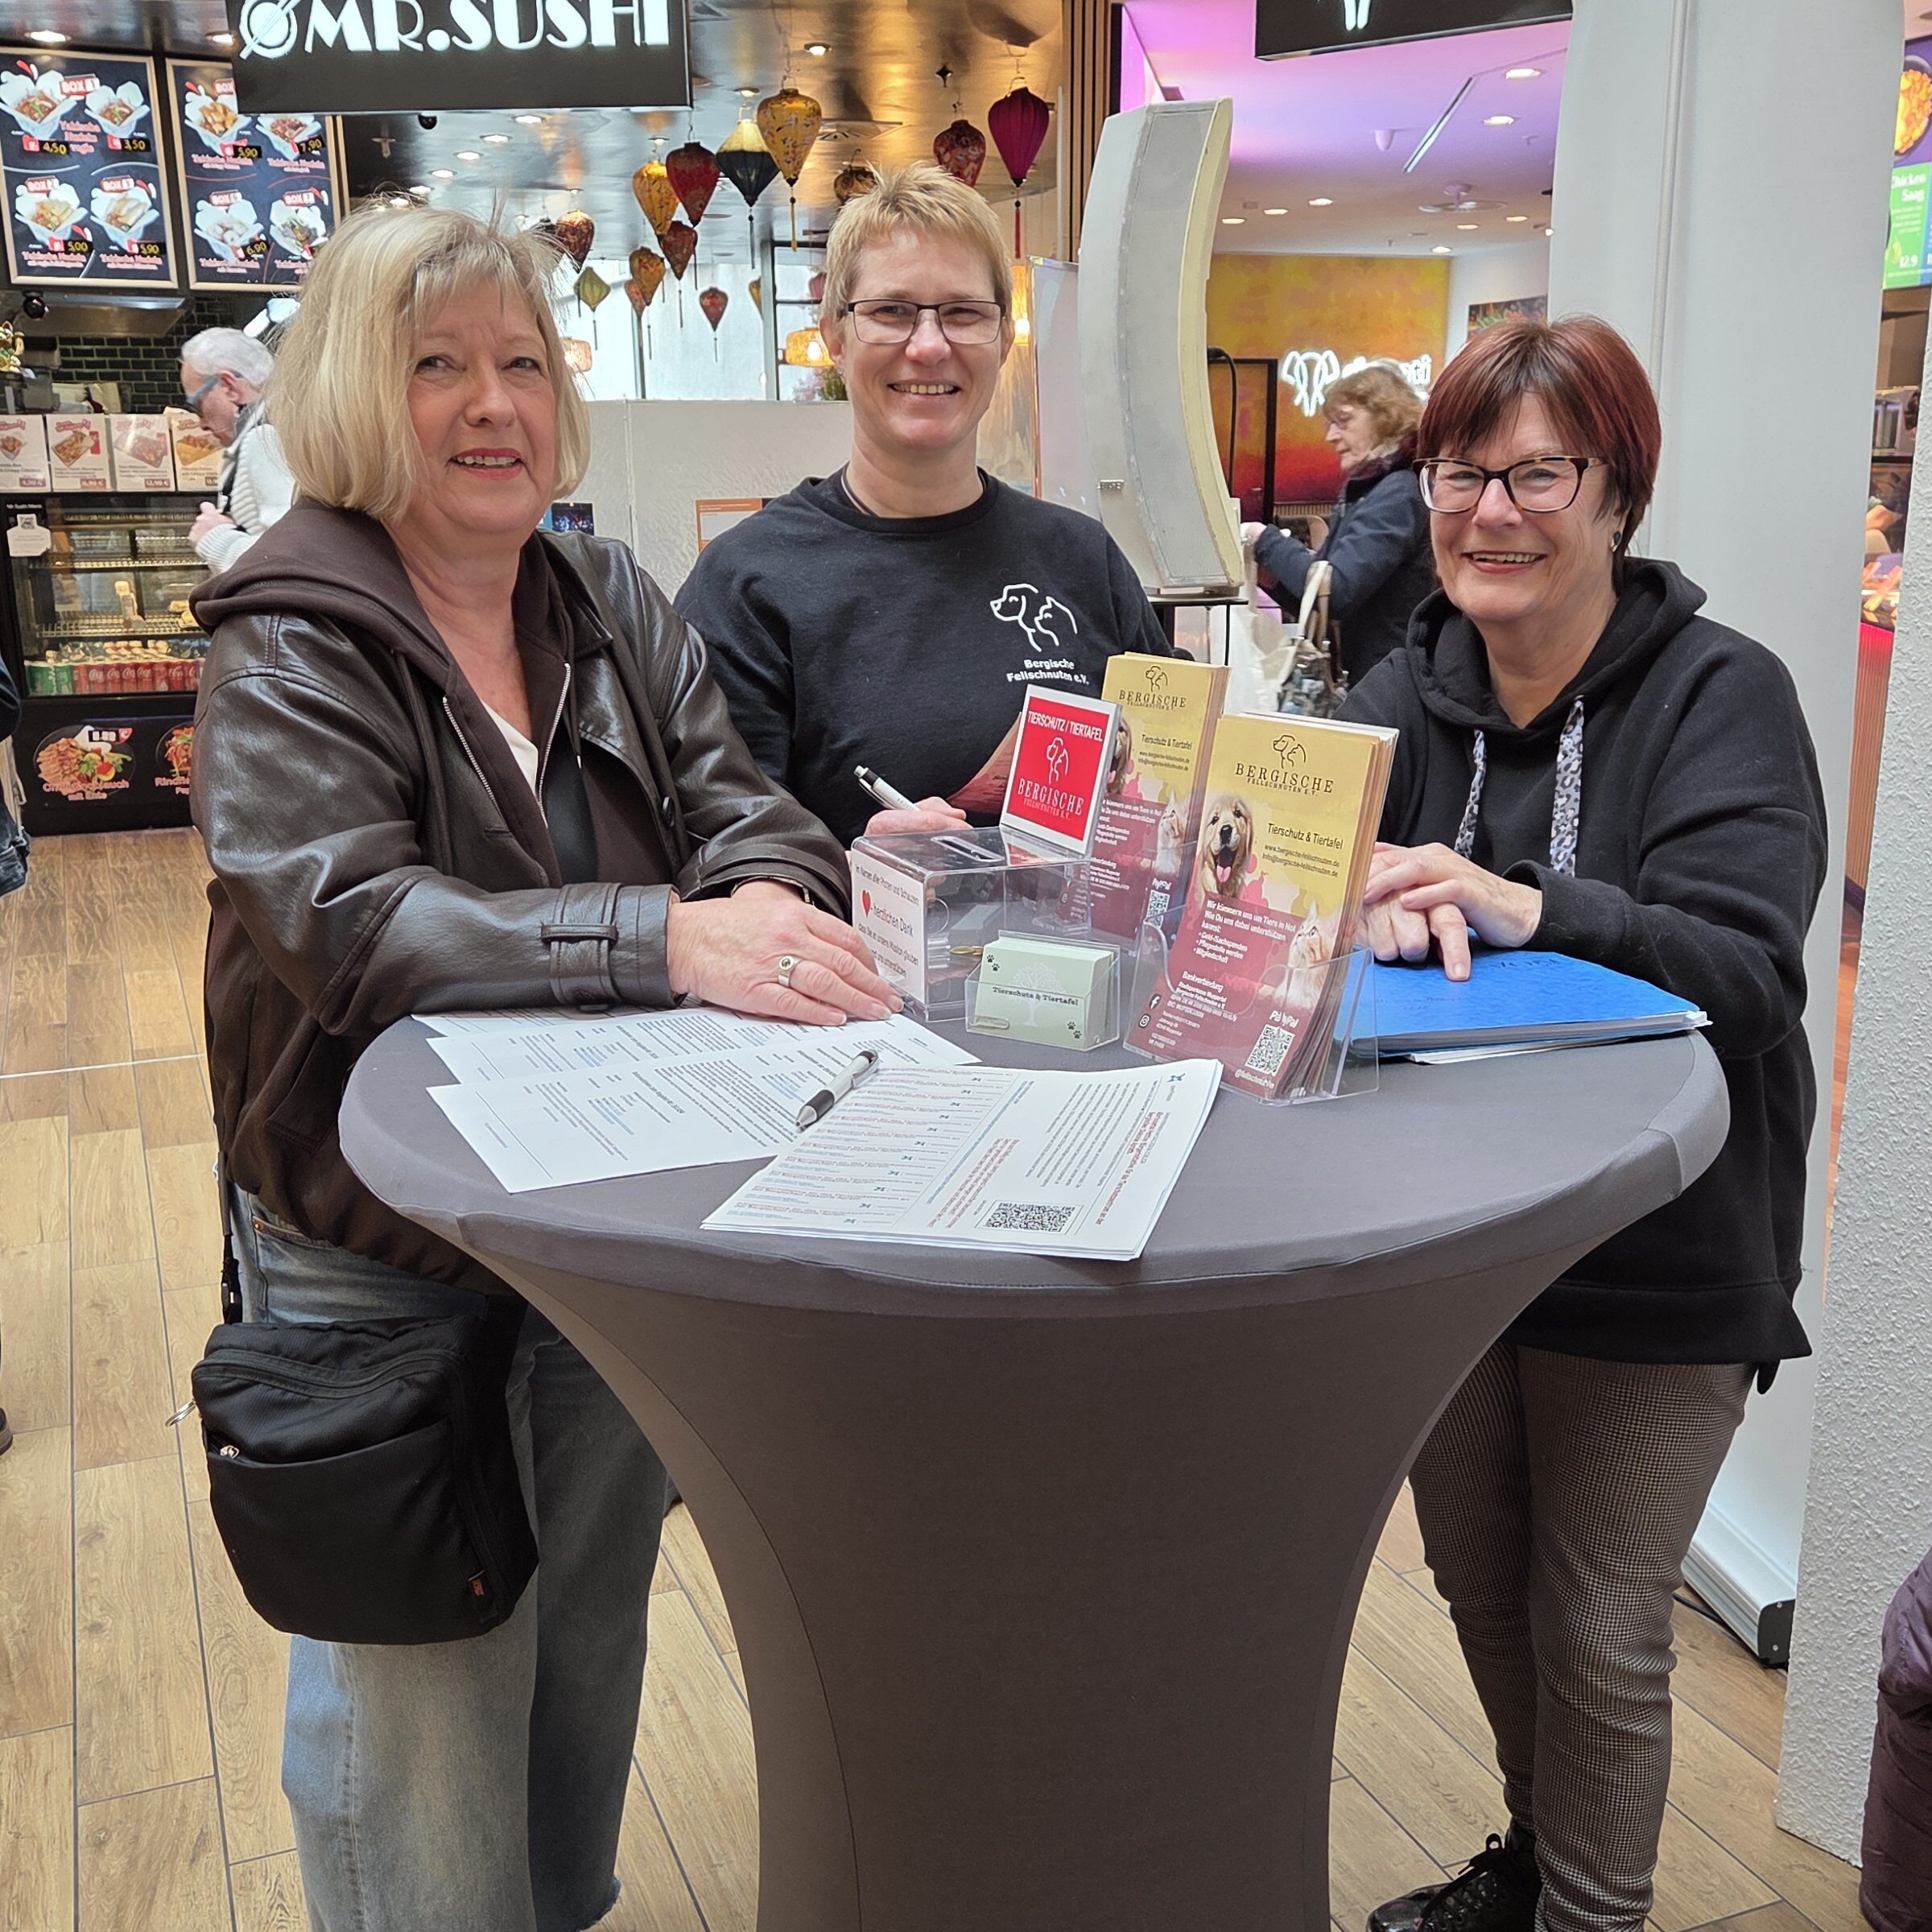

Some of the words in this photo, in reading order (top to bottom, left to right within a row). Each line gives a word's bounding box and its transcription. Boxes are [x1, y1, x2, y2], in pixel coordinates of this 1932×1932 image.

[1024, 658, 1075, 669] Bergische
[1007, 671, 1072, 682] Fellschnuten
[1074, 674, 1090, 684] e.V.
[1119, 689, 1187, 708] BERGISCHE
[1027, 710, 1065, 731] TIERSCHUTZ
[1070, 720, 1103, 742] TIERTAFEL
[1141, 733, 1166, 746] Tierschutz
[1172, 738, 1192, 750] Tiertafel
[1235, 762, 1334, 794] BERGISCHE
[1247, 778, 1302, 794] FELLSCHNUTEN
[1018, 778, 1084, 815] BERGISCHE
[1268, 823, 1304, 841] Tierschutz
[1306, 832, 1311, 841] &
[1313, 833, 1344, 850] Tiertafel
[1216, 913, 1223, 923] Du
[1285, 922, 1296, 933] Not
[993, 987, 1034, 999] Tierschutz
[1042, 994, 1079, 1005] Tiertafel
